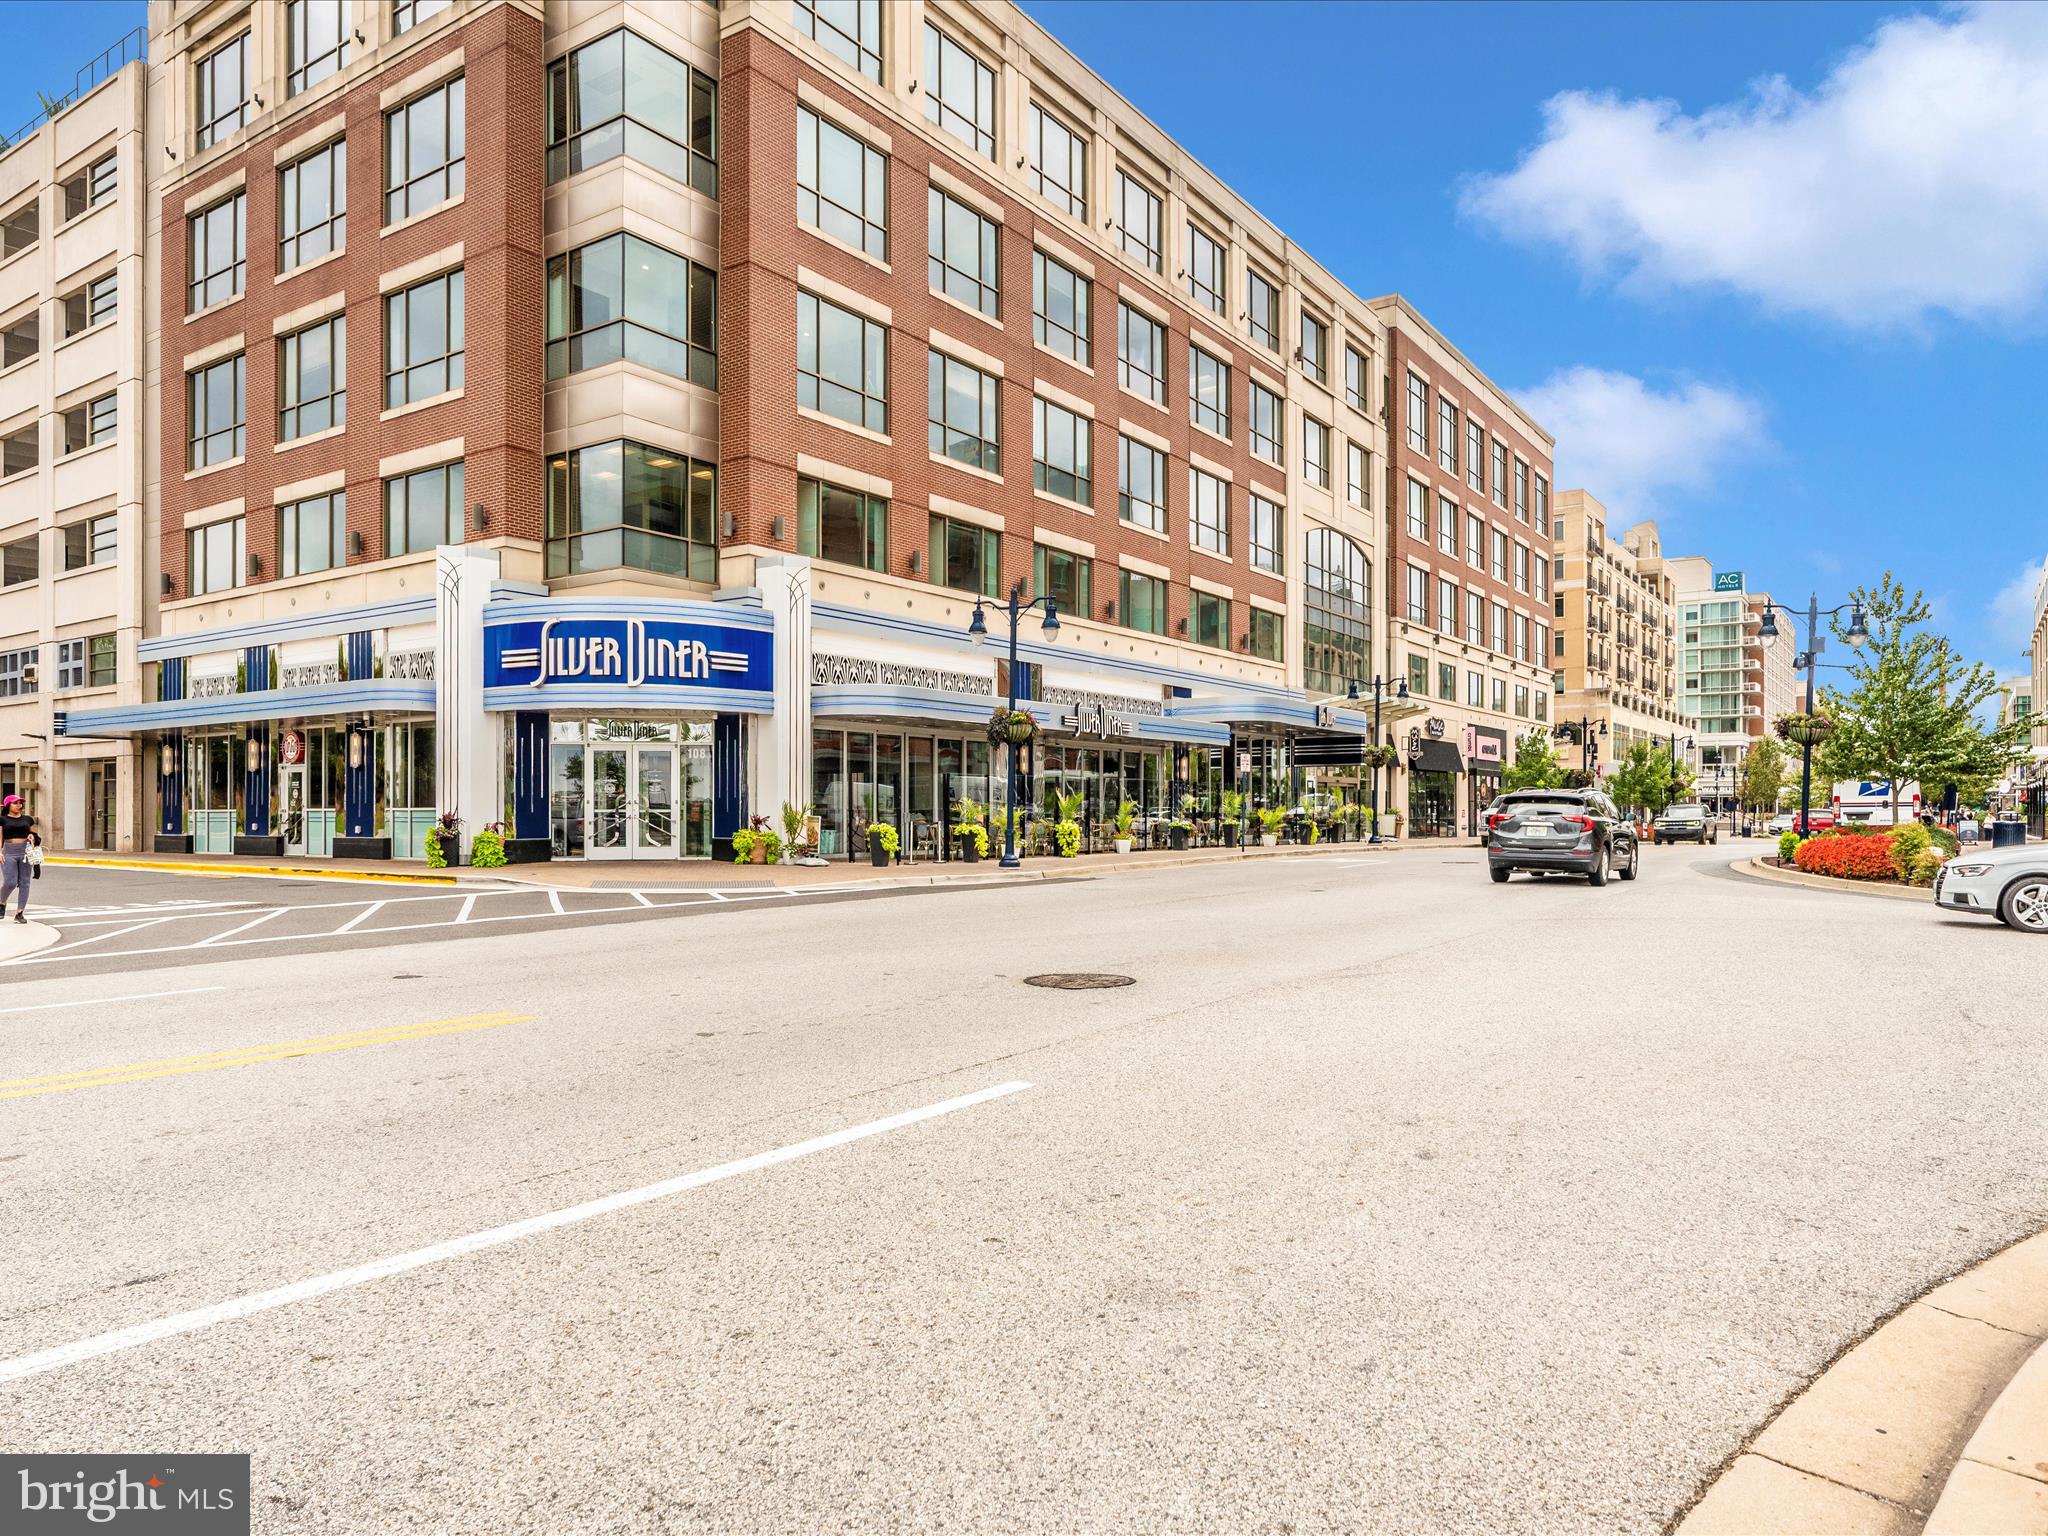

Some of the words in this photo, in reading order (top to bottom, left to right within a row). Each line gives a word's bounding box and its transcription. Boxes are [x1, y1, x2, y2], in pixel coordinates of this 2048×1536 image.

[1718, 574, 1738, 584] AC
[530, 617, 622, 688] SILVER
[627, 617, 710, 688] DINER
[687, 748, 706, 759] 108
